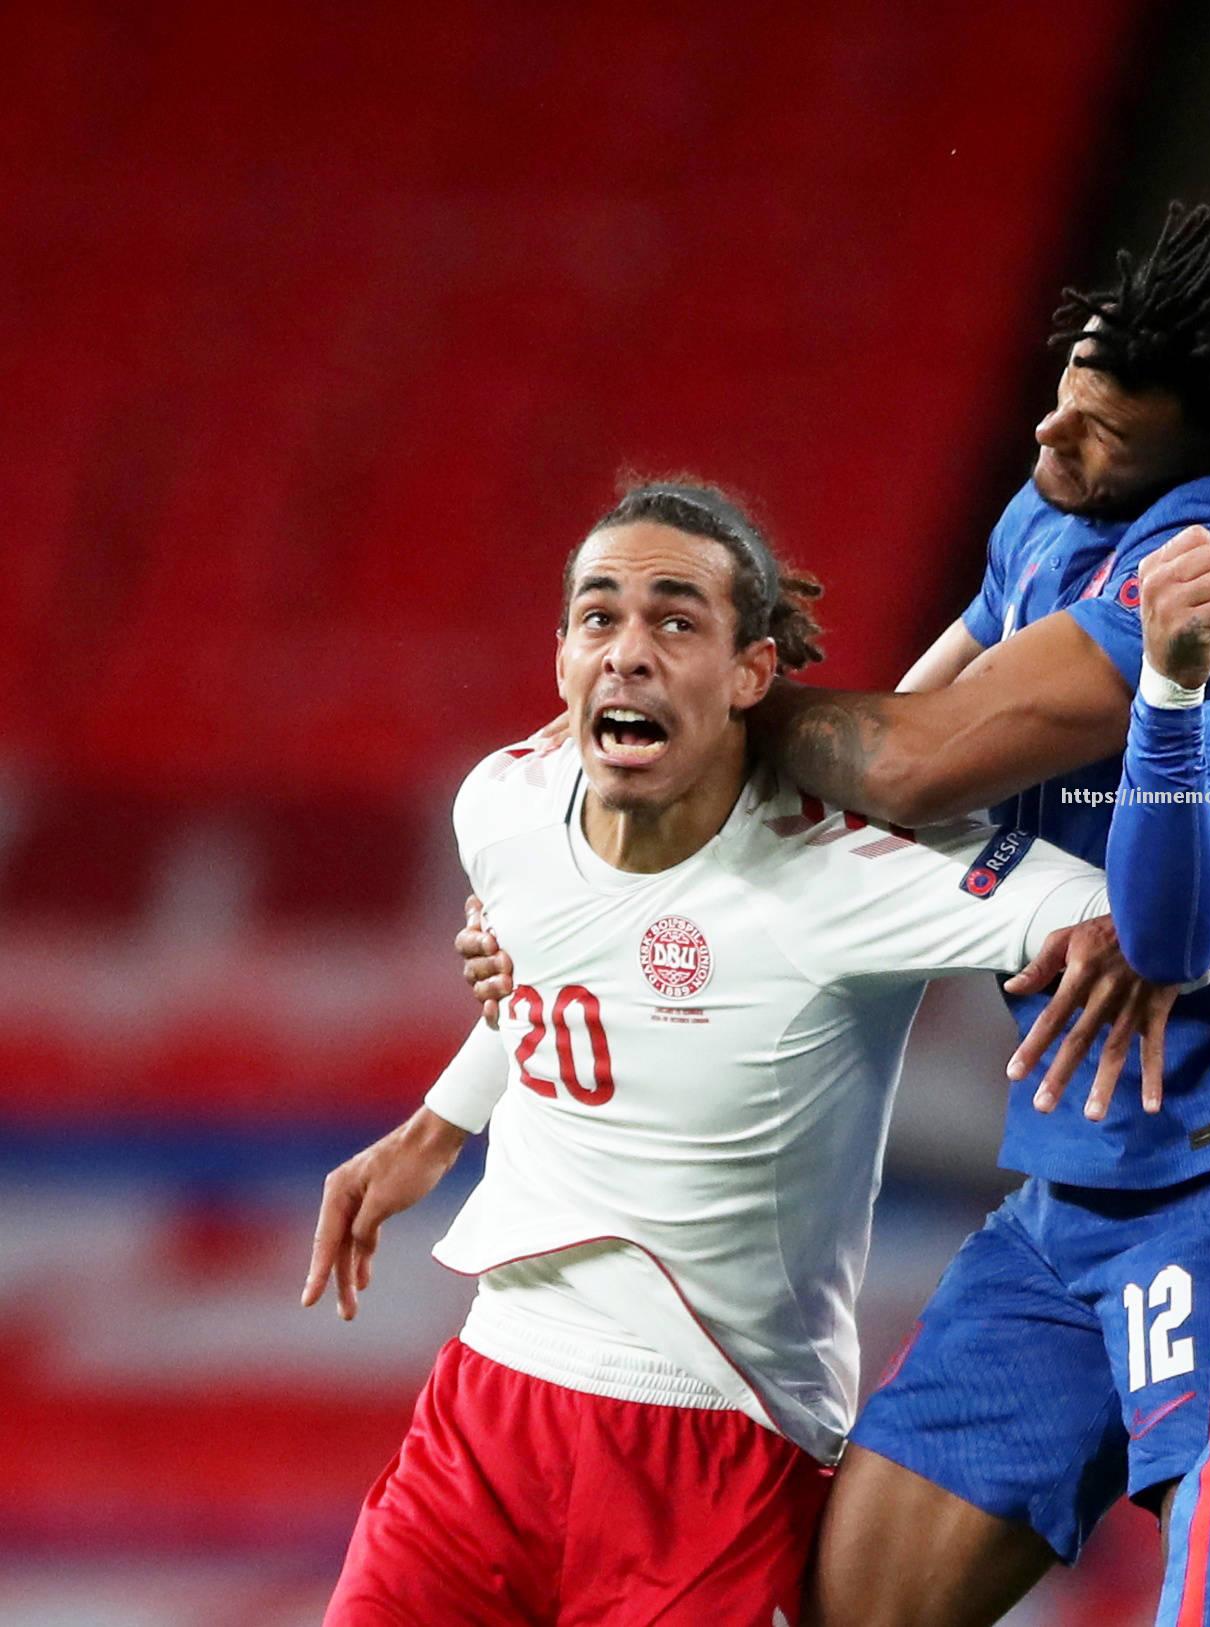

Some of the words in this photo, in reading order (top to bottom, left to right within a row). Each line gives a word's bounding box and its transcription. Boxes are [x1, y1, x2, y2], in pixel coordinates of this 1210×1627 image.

[653, 942, 697, 970] DBU
[509, 984, 615, 1106] 20
[1123, 1264, 1195, 1393] 12
